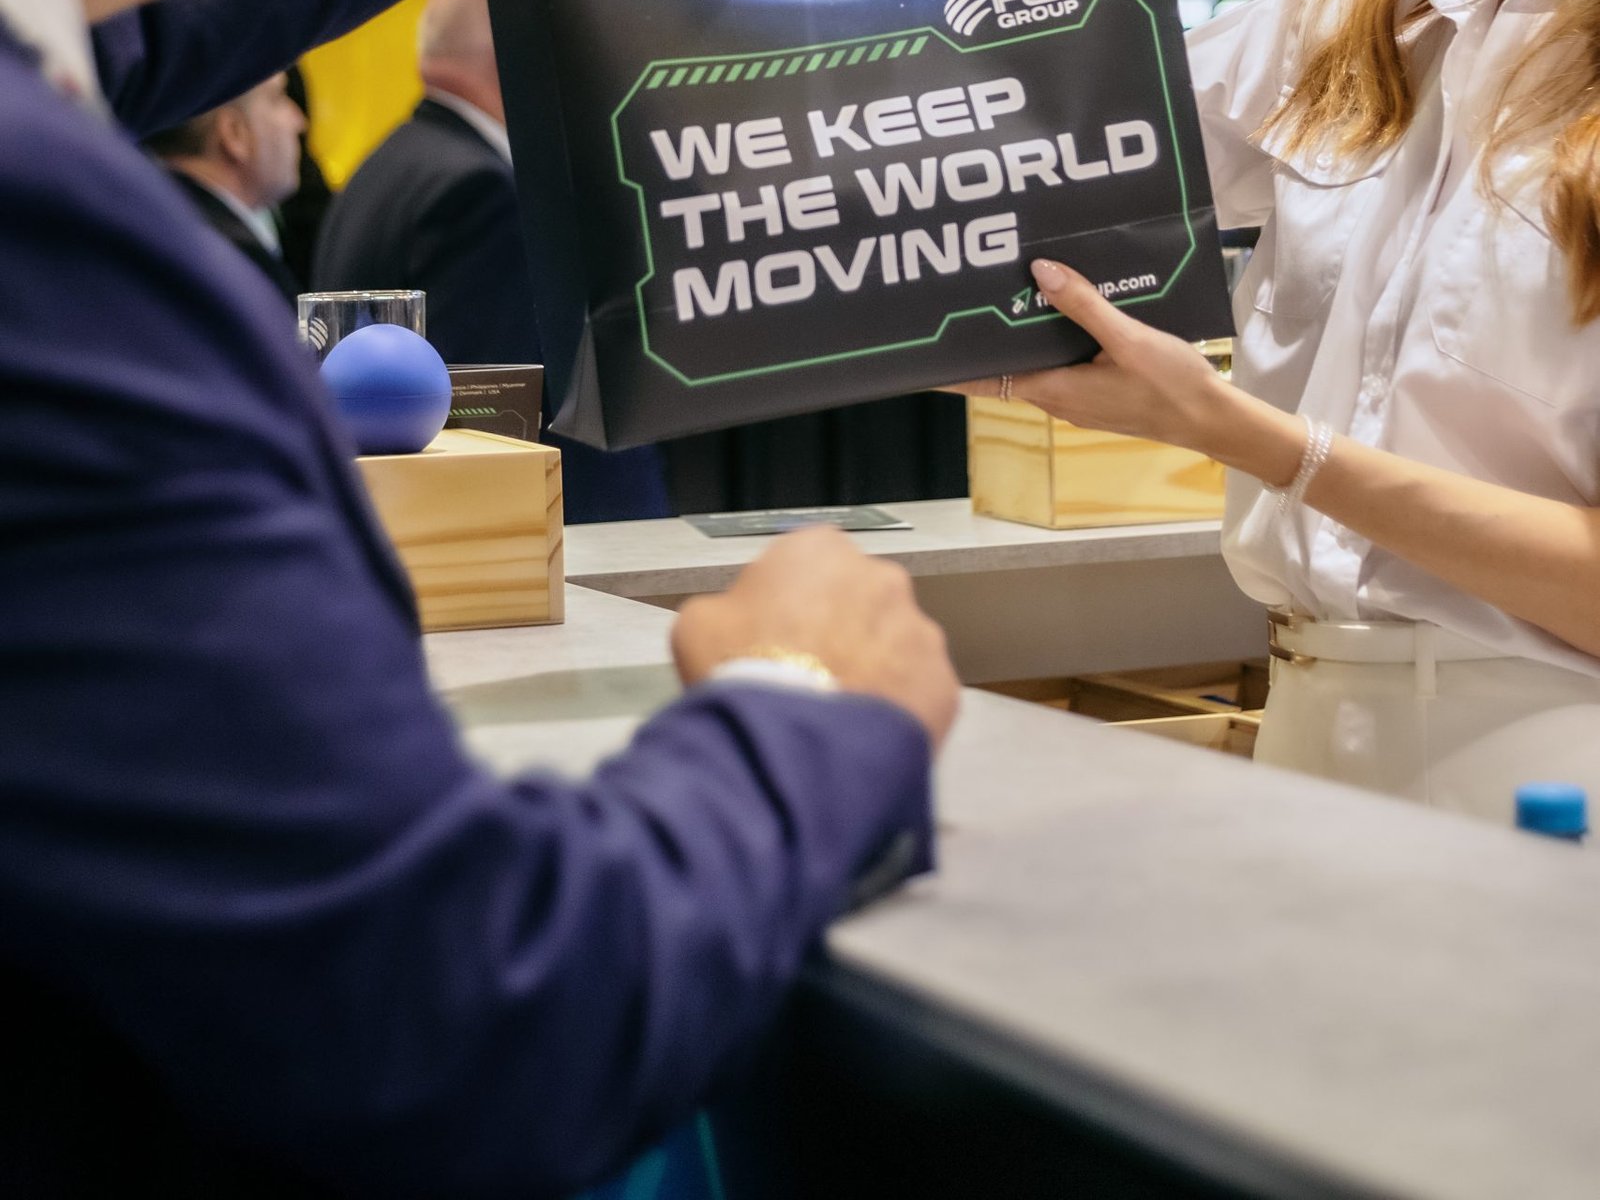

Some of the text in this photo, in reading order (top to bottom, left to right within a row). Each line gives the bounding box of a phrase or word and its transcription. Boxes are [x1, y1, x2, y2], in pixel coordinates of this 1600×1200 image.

[649, 76, 1027, 180] WE KEEP
[660, 119, 1159, 250] THE WORLD
[672, 211, 1020, 323] MOVING
